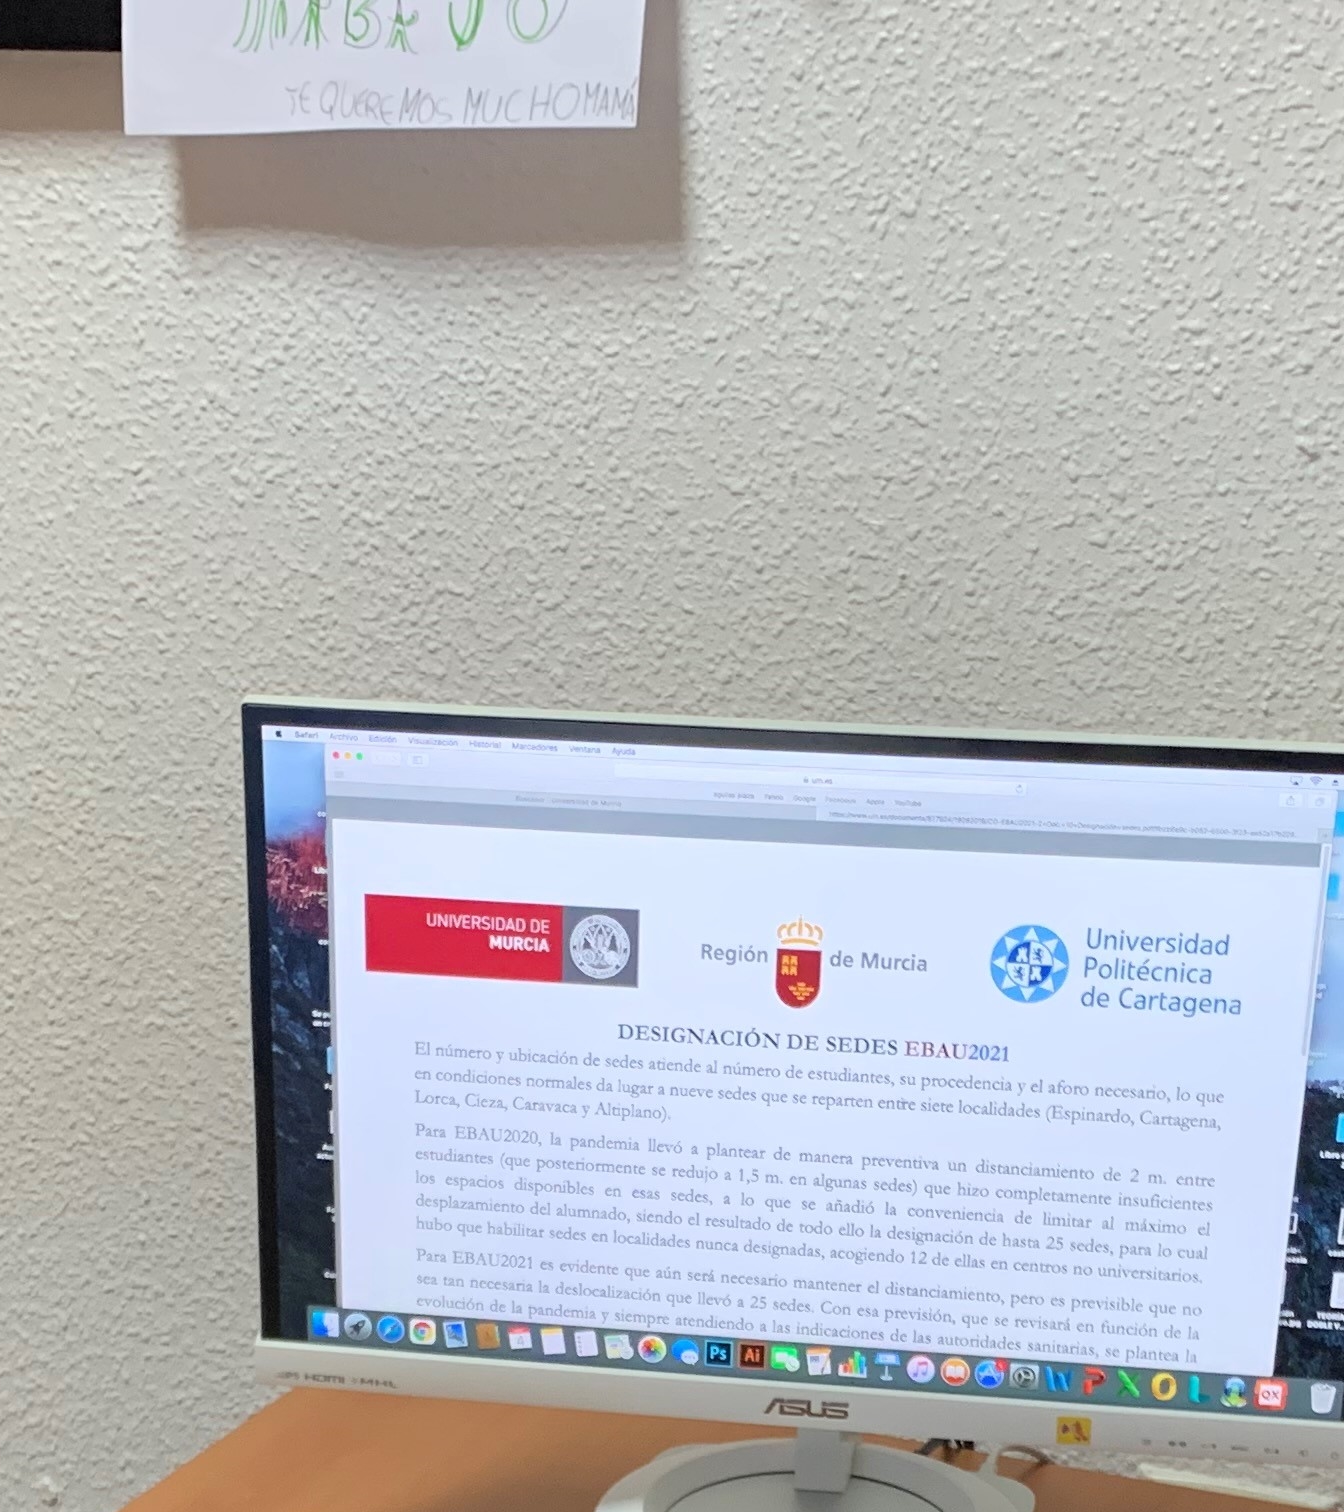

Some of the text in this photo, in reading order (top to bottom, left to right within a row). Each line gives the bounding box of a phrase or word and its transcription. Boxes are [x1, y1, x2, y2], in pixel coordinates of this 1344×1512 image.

[285, 81, 311, 117] TE
[319, 80, 453, 125] QUEREMOS
[294, 730, 319, 740] Safari
[329, 732, 359, 742] Archivo
[368, 733, 398, 744] Edición
[469, 739, 502, 749] Historial
[511, 742, 558, 753] Marcadores
[568, 744, 601, 755] Ventana
[611, 746, 636, 757] Ayuda
[426, 912, 551, 935] UNIVERSIDAD DE
[488, 935, 551, 953] MURCIA
[1086, 927, 1231, 956] Universidad
[700, 943, 928, 972] Región de Murcia
[1083, 956, 1212, 985] Politécnica
[1080, 985, 1242, 1018] de Cartagena
[617, 1023, 1010, 1062] DESIGNACIÓN DE SEDES EBAU2021
[414, 1040, 1225, 1108] El número y ubicación de sedes atiende al número de estudiantes, su procedencia y el aforo necesario, lo que
[414, 1068, 1222, 1132] en condiciones normales da lugar a nueve sedes que se reparten entre siete localidades (Espinardo, Cartagena,
[414, 1089, 672, 1124] Lorca, Cieza, Caravaca y Altiplano).
[414, 1122, 1216, 1188] Para EBAU2020, la pandemia llevó a plantear de manera preventiva un distanciamiento de 2 m. entre
[415, 1247, 1203, 1318] Para EBAU2021 es evidente que aún será necesario mantener el distanciamiento, pero es previsible que no
[709, 1344, 727, 1361] Ps
[744, 1347, 760, 1363] Ai
[764, 1397, 850, 1420] ASUS
